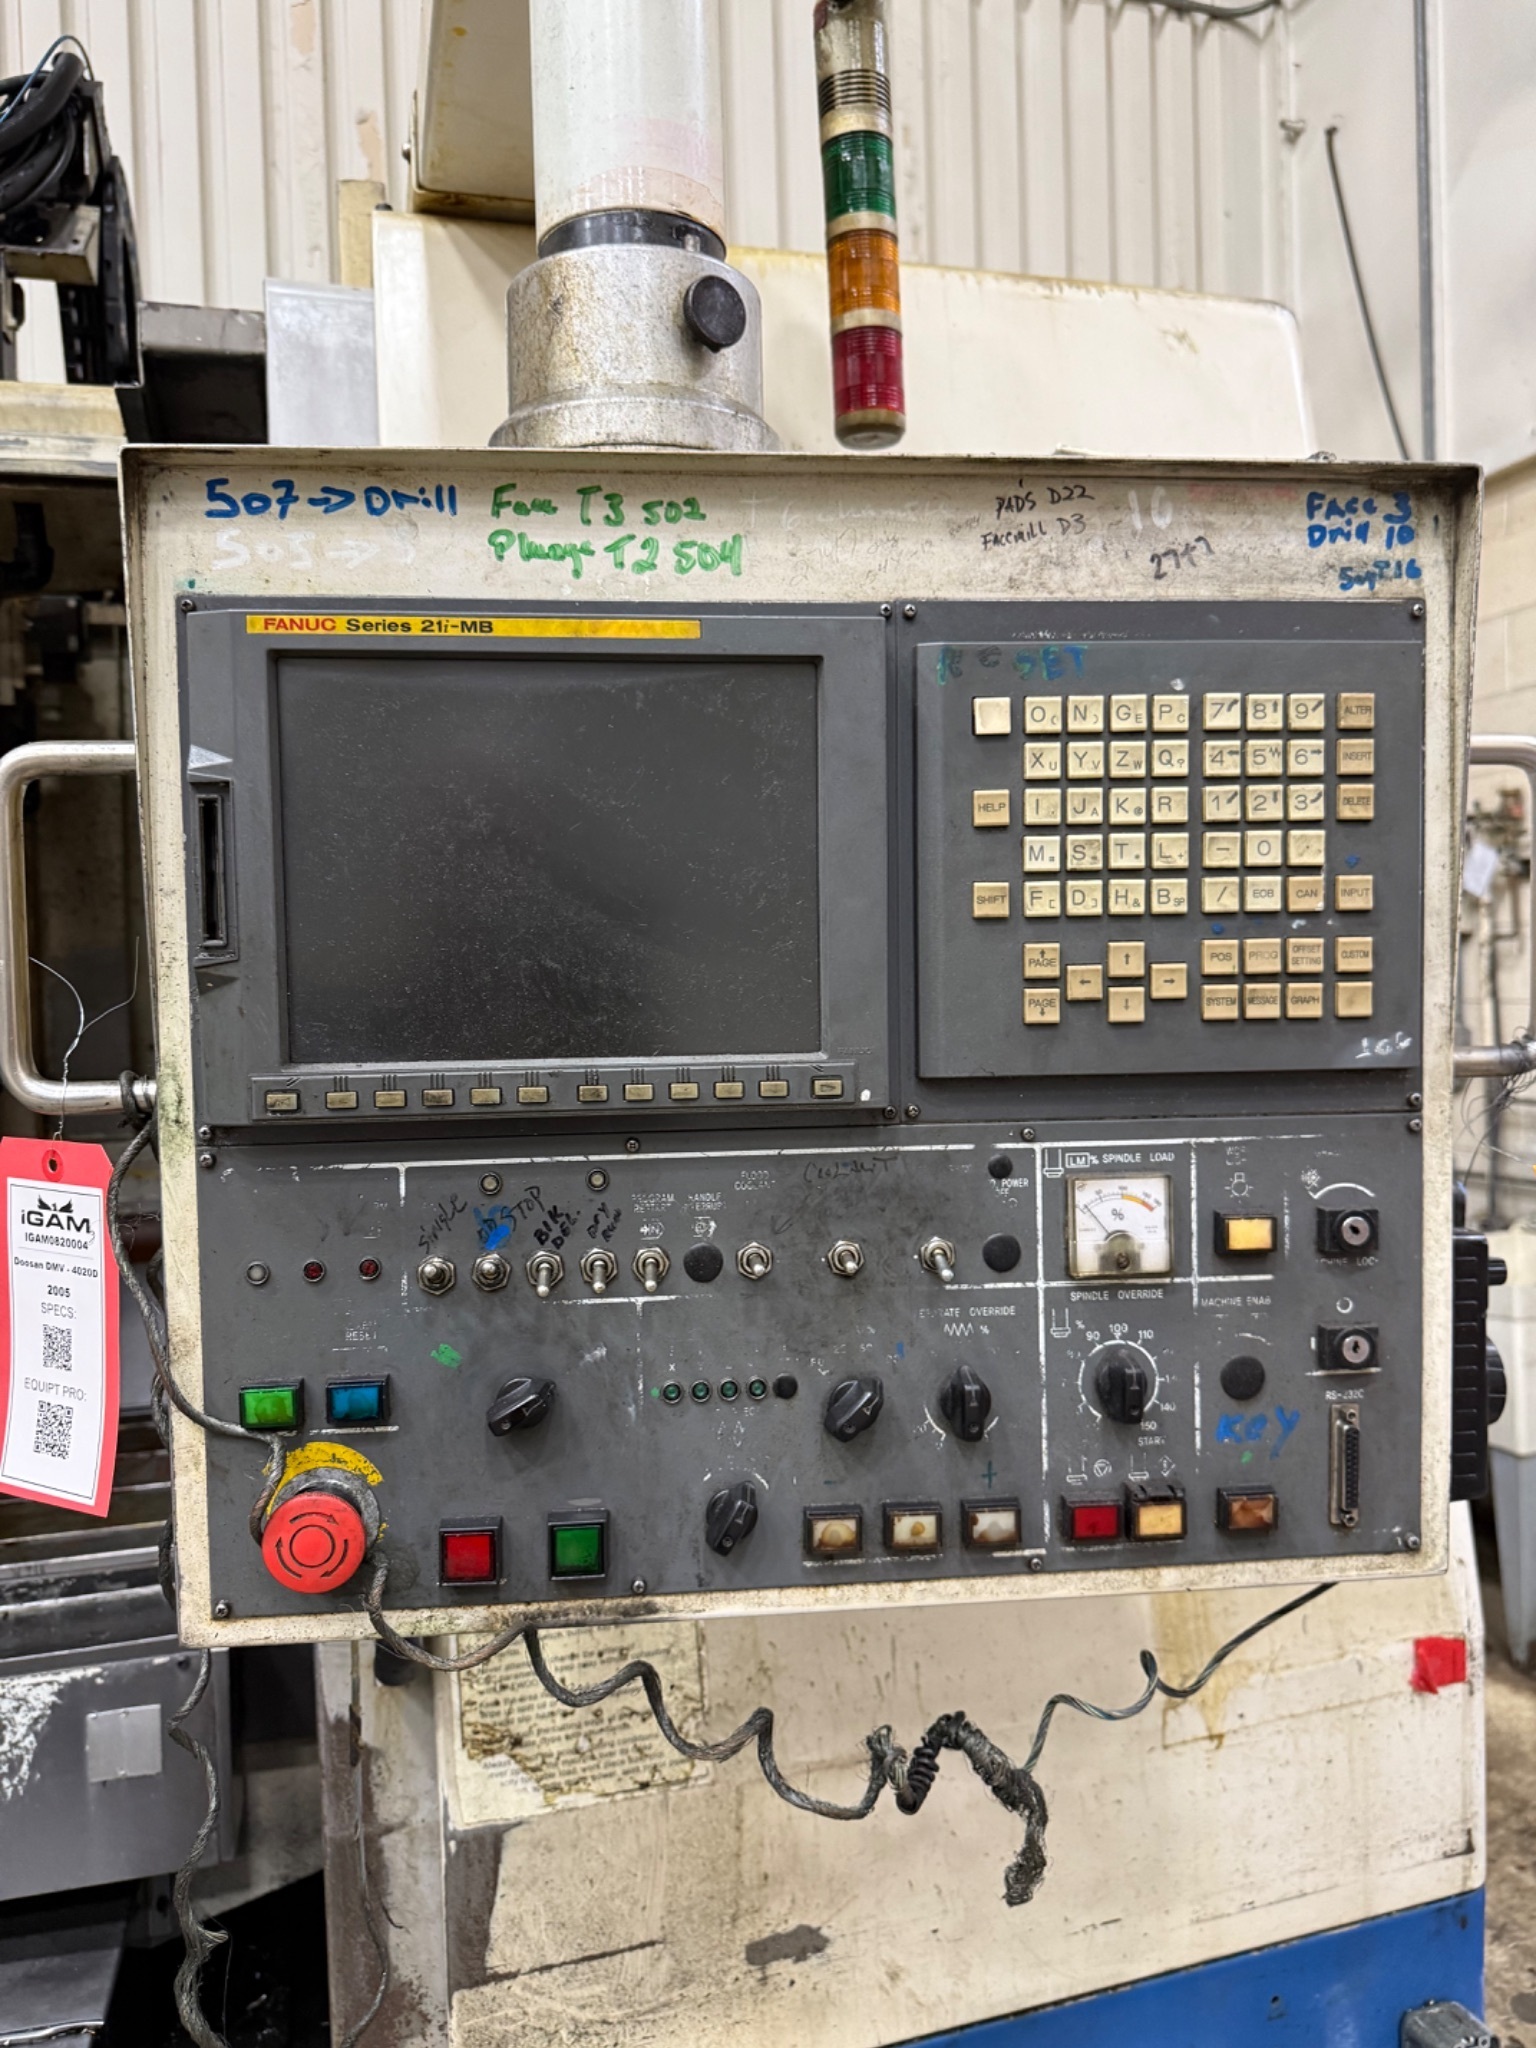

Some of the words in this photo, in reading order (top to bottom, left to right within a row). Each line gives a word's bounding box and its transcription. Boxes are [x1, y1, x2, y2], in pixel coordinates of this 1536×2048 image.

[204, 478, 299, 519] 507
[263, 617, 336, 632] FANUC
[346, 618, 411, 633] Series
[421, 619, 494, 634] 21i-MB
[1074, 705, 1087, 721] N
[1116, 704, 1131, 721] G
[1159, 704, 1172, 721] P
[1211, 703, 1225, 719] 7
[1252, 703, 1267, 719] 8
[1295, 703, 1309, 719] 9
[1343, 706, 1372, 715] ALTER
[1031, 752, 1045, 768] X
[1073, 751, 1088, 768] Y
[1116, 751, 1129, 767] Z
[1158, 749, 1174, 767] Q
[1210, 750, 1225, 765] 4
[1252, 749, 1266, 765] 5
[1294, 749, 1309, 765] 6
[1342, 751, 1372, 760] INSERT
[978, 802, 1006, 812] HELP
[1073, 798, 1087, 814] J
[1116, 797, 1130, 814] K
[1158, 796, 1172, 812] R
[1211, 795, 1220, 811] 1
[1252, 795, 1267, 811] 2
[1294, 795, 1308, 810] 3
[1342, 796, 1372, 806] DELETE
[1029, 845, 1045, 861] M
[1072, 845, 1086, 861] S
[1115, 843, 1129, 859] T
[1159, 843, 1172, 859] L
[976, 895, 1006, 904] SHIFT
[1030, 890, 1043, 907] F
[1072, 889, 1086, 906] D
[1115, 889, 1128, 905] H
[1157, 888, 1171, 904] B
[1252, 889, 1274, 899] EOB
[1296, 889, 1318, 898] CAN
[1341, 888, 1370, 897] INPUT
[1028, 957, 1056, 967] PAGE
[1210, 952, 1232, 961] POS
[1249, 951, 1278, 960] PROG
[1291, 957, 1321, 966] SETTING
[1028, 998, 1056, 1008] PAGE
[1205, 997, 1237, 1006] SYSTEM
[1290, 996, 1320, 1005] GRAPH
[1102, 1153, 1142, 1163] SPINDLE
[1150, 1152, 1175, 1162] LOAD
[1001, 1178, 1029, 1188] POWER
[14, 1256, 44, 1270] Doosan
[46, 1262, 65, 1273] DMV
[47, 1284, 71, 1298] 2005
[1070, 1290, 1109, 1301] SPINDLE
[1118, 1289, 1164, 1300] OVERRIDE
[41, 1302, 77, 1319] SPECS:
[969, 1306, 1016, 1317] OVERRIDE
[1086, 1331, 1100, 1341] 90
[1109, 1323, 1129, 1333] 100
[1138, 1330, 1154, 1339] 110
[24, 1377, 60, 1396] EQUIPT
[62, 1385, 87, 1402] PRO:
